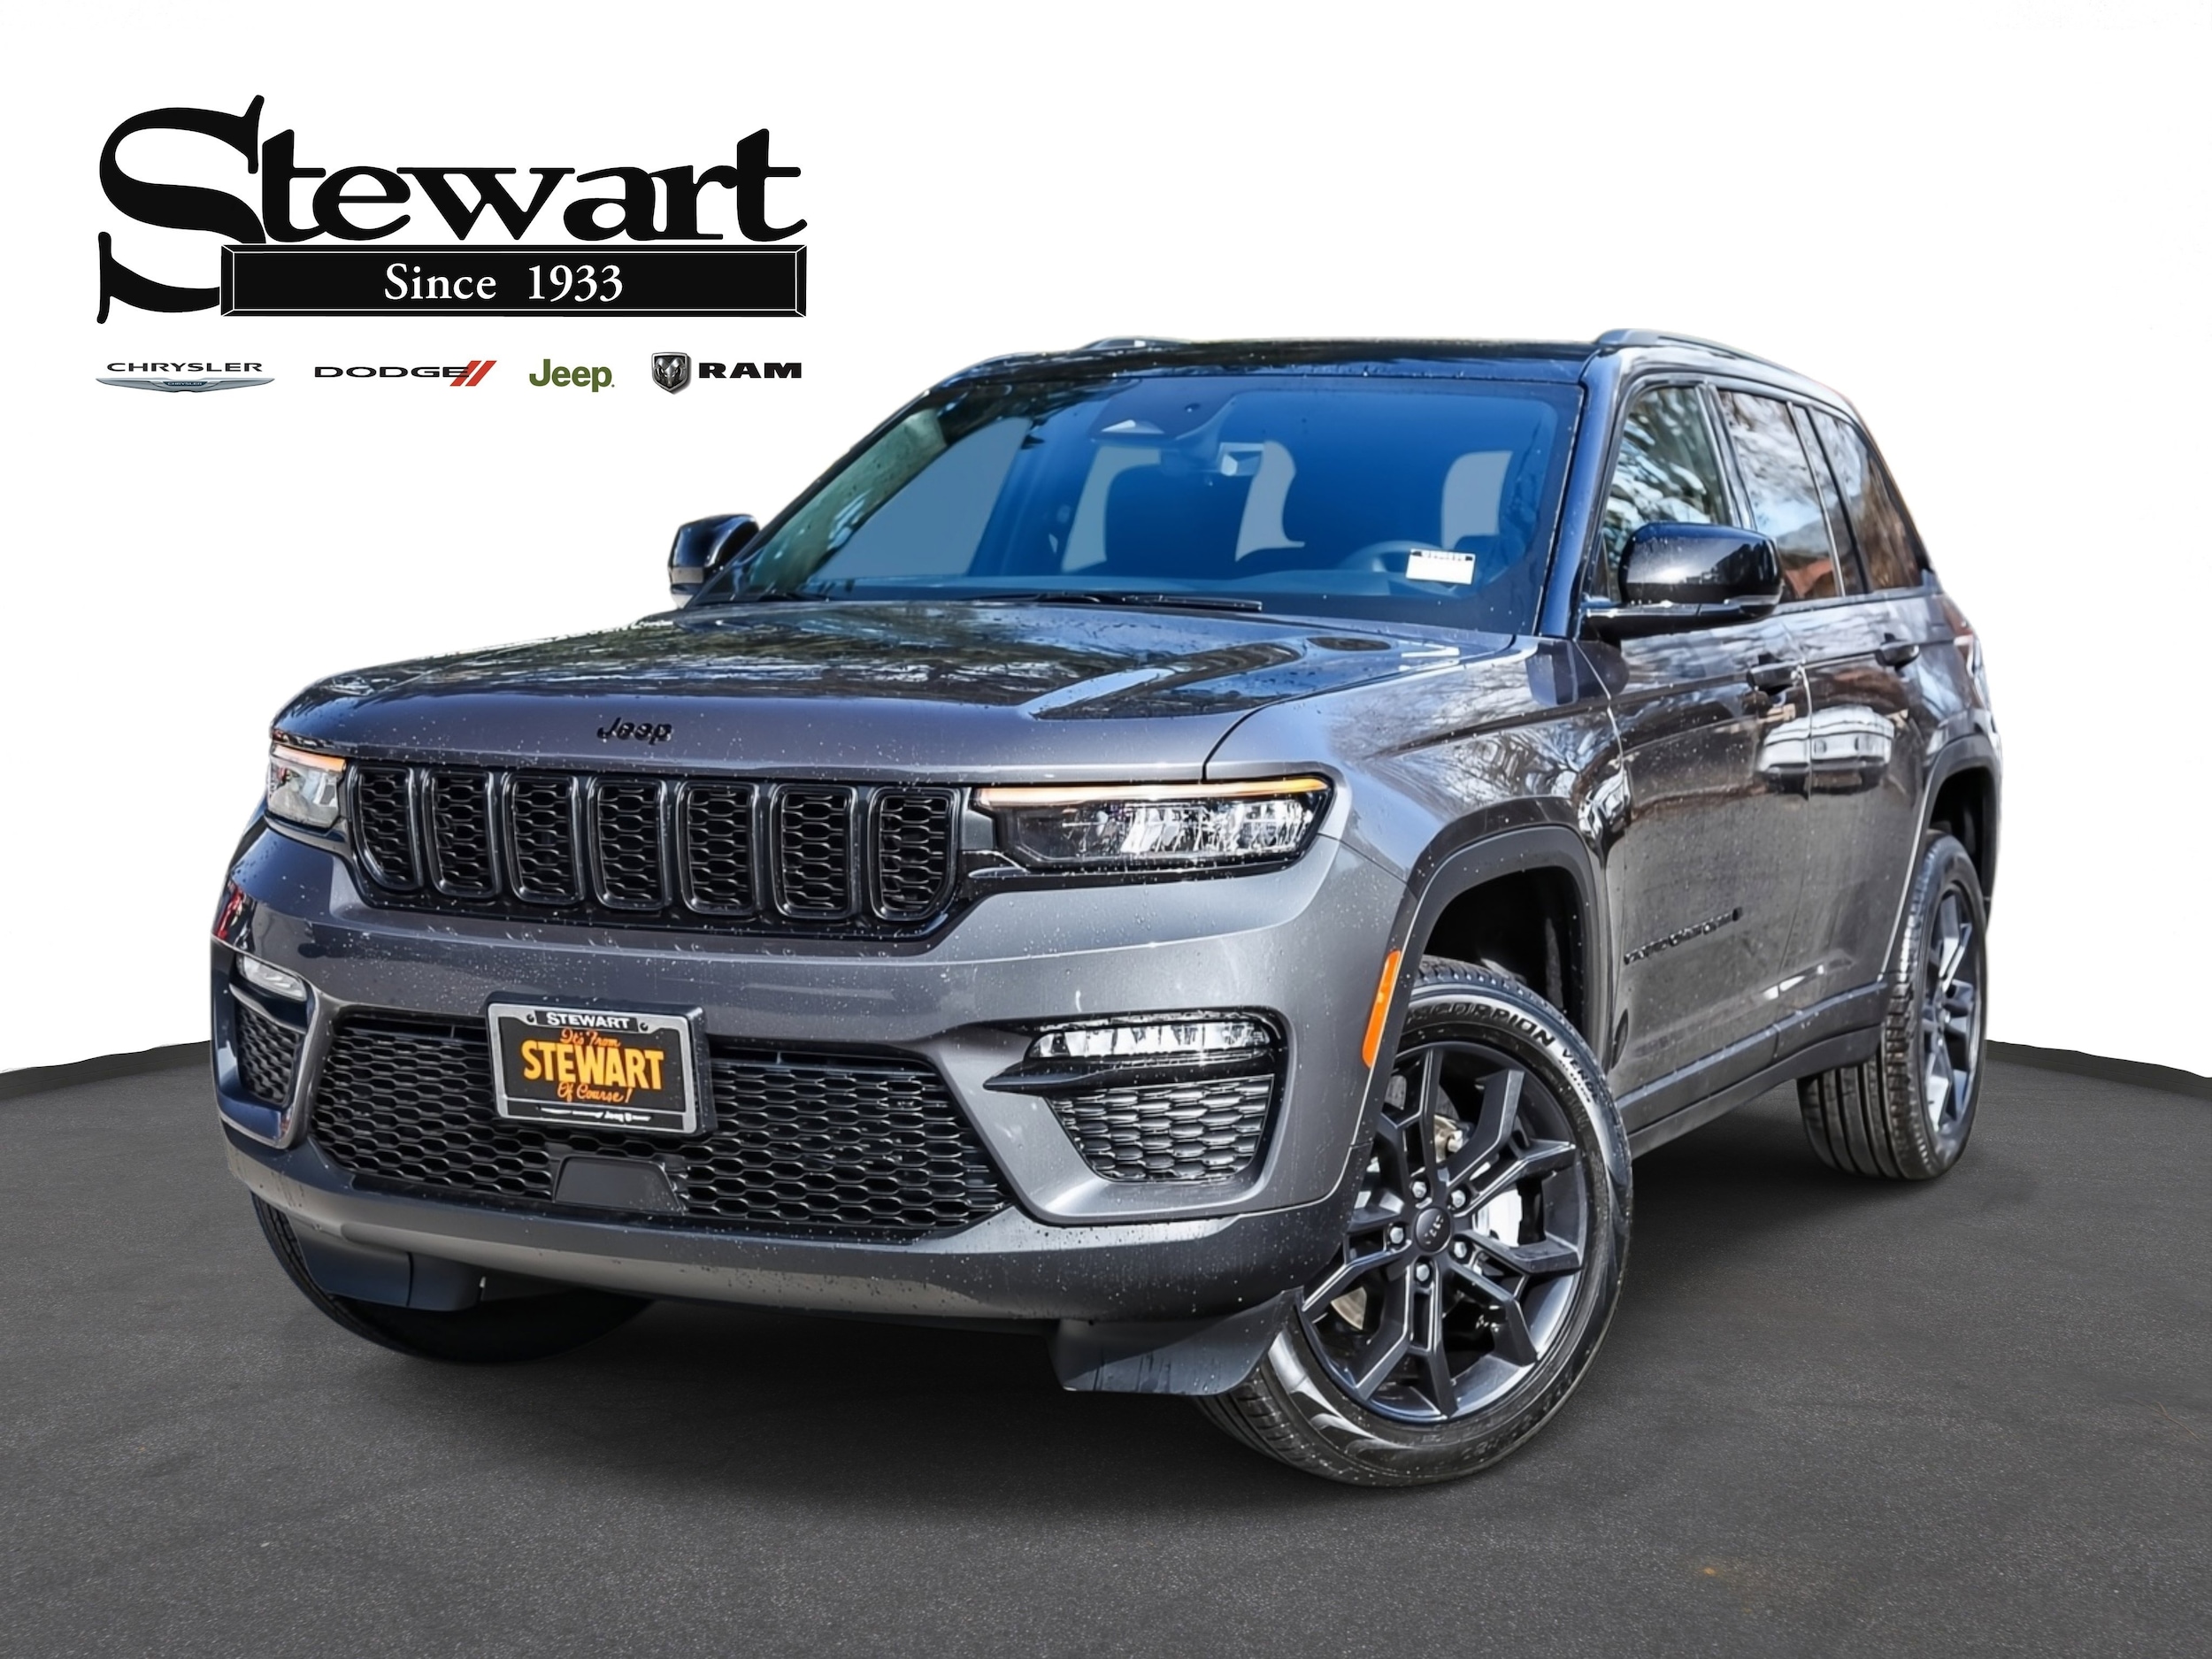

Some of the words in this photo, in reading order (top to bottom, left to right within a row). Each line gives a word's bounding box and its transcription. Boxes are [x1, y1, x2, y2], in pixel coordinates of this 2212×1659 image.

[596, 717, 672, 745] Jeep
[546, 1011, 630, 1029] STEWART
[521, 1040, 664, 1090] STEWART
[557, 1081, 573, 1102] Of
